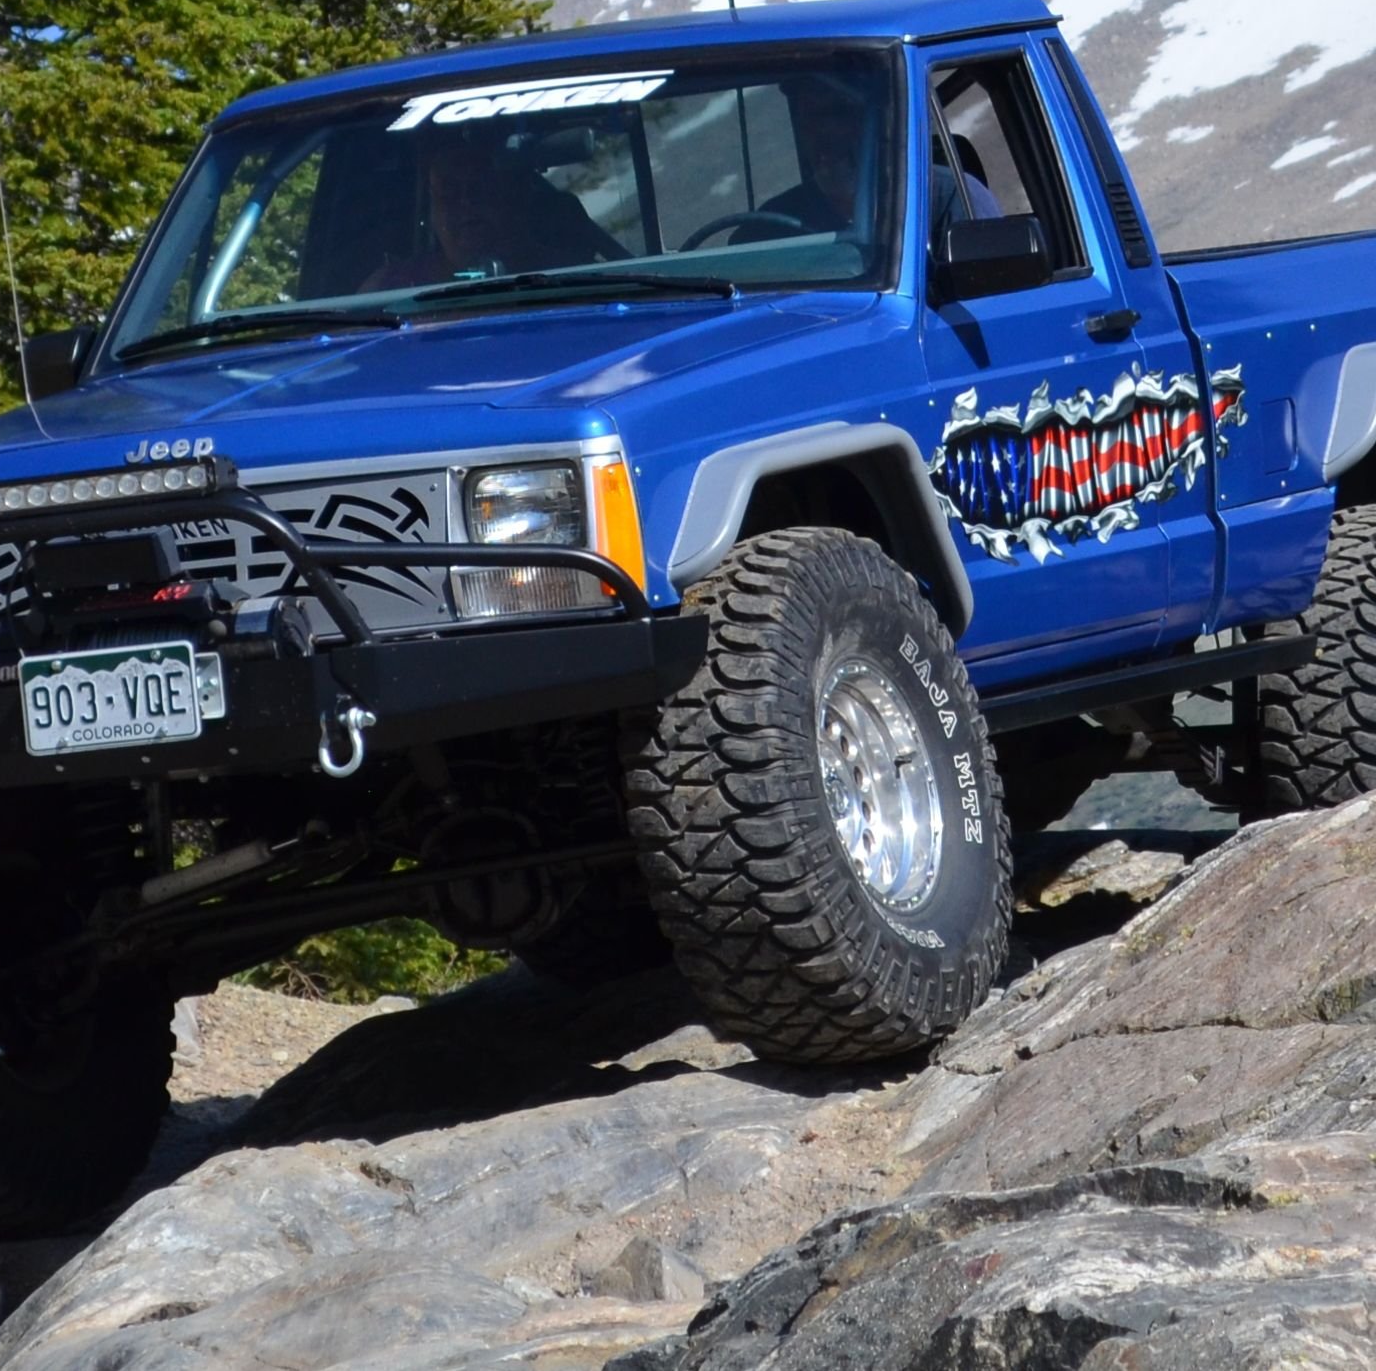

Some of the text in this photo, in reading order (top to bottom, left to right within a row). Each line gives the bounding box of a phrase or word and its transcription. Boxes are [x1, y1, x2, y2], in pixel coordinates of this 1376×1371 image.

[126, 436, 213, 464] Jeep
[72, 722, 155, 742] COLORADO
[899, 633, 983, 844] BAJA MTZ
